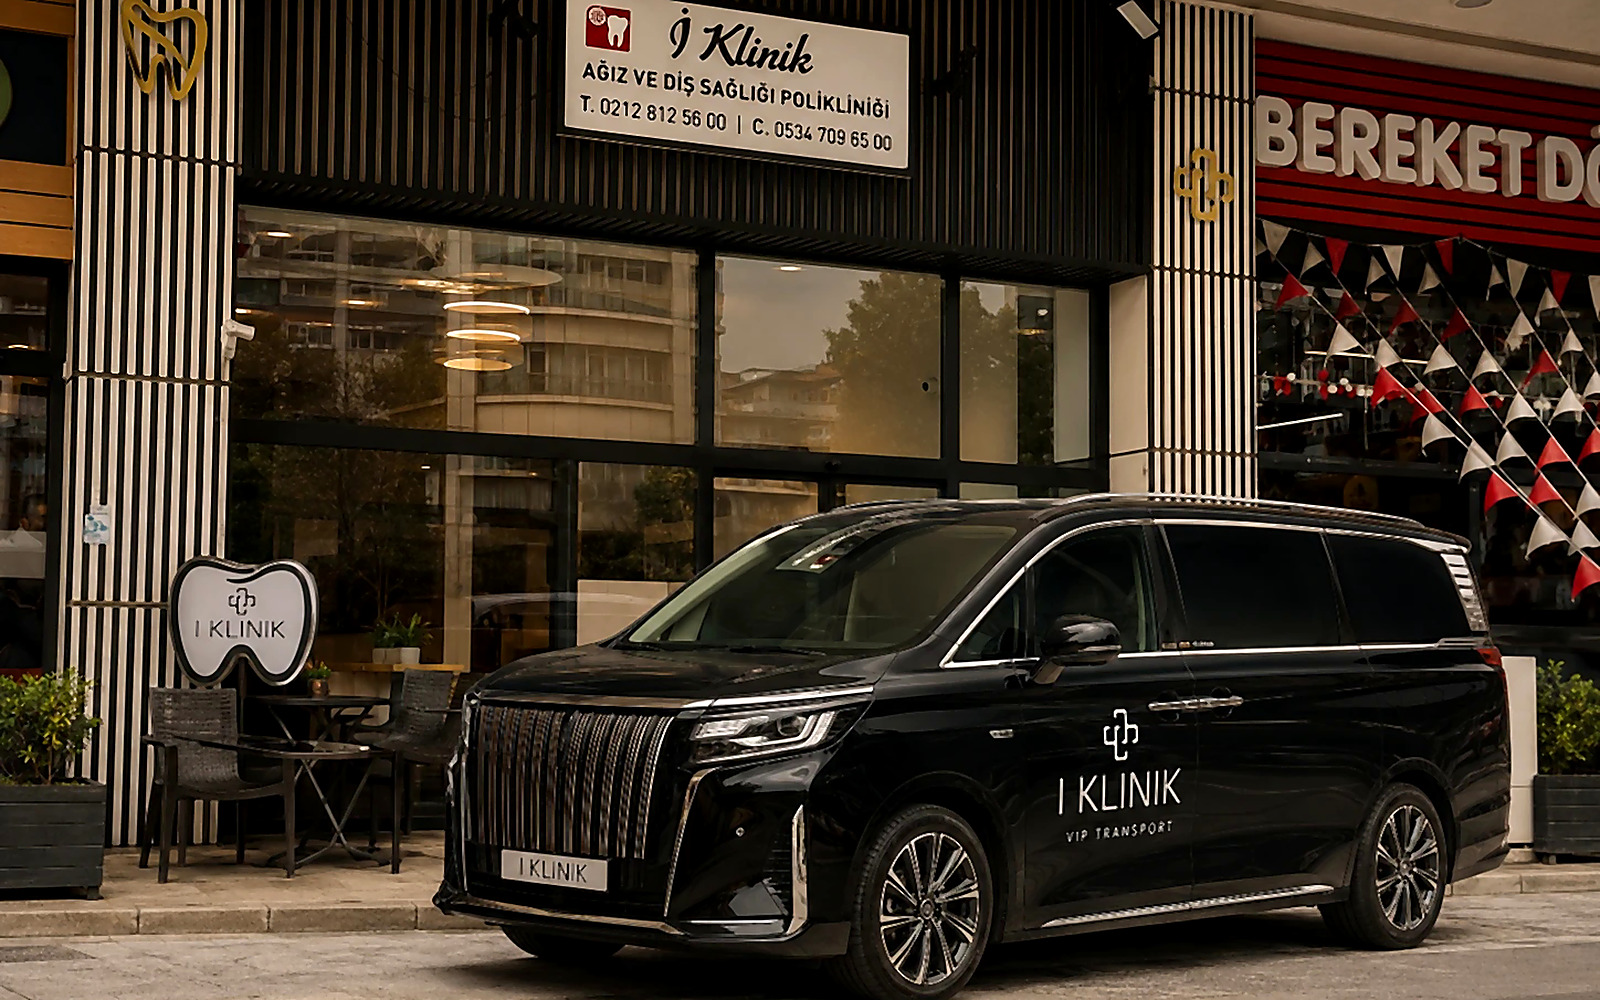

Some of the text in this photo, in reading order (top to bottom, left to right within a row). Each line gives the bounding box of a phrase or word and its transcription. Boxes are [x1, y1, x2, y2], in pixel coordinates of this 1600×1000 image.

[699, 23, 814, 74] Klinik
[582, 59, 889, 119] AĞIZ VE DİŞ SAĞLIĞI POLİKLİNİĞİ
[580, 94, 594, 113] T.
[600, 97, 641, 119] 0212
[647, 104, 677, 124] 812
[682, 108, 701, 127] 56
[706, 112, 726, 131] 00
[752, 117, 769, 136] C.
[774, 121, 812, 141] 0534
[817, 126, 846, 145] 709
[850, 130, 869, 149] 65
[873, 133, 892, 151] 00
[1255, 95, 1532, 198] BEREKET
[195, 619, 285, 639] I KLINIK
[1058, 767, 1182, 815] I KLINIK
[1065, 820, 1173, 843] VIP TRANSPORT
[520, 857, 587, 883] I KLINIK
